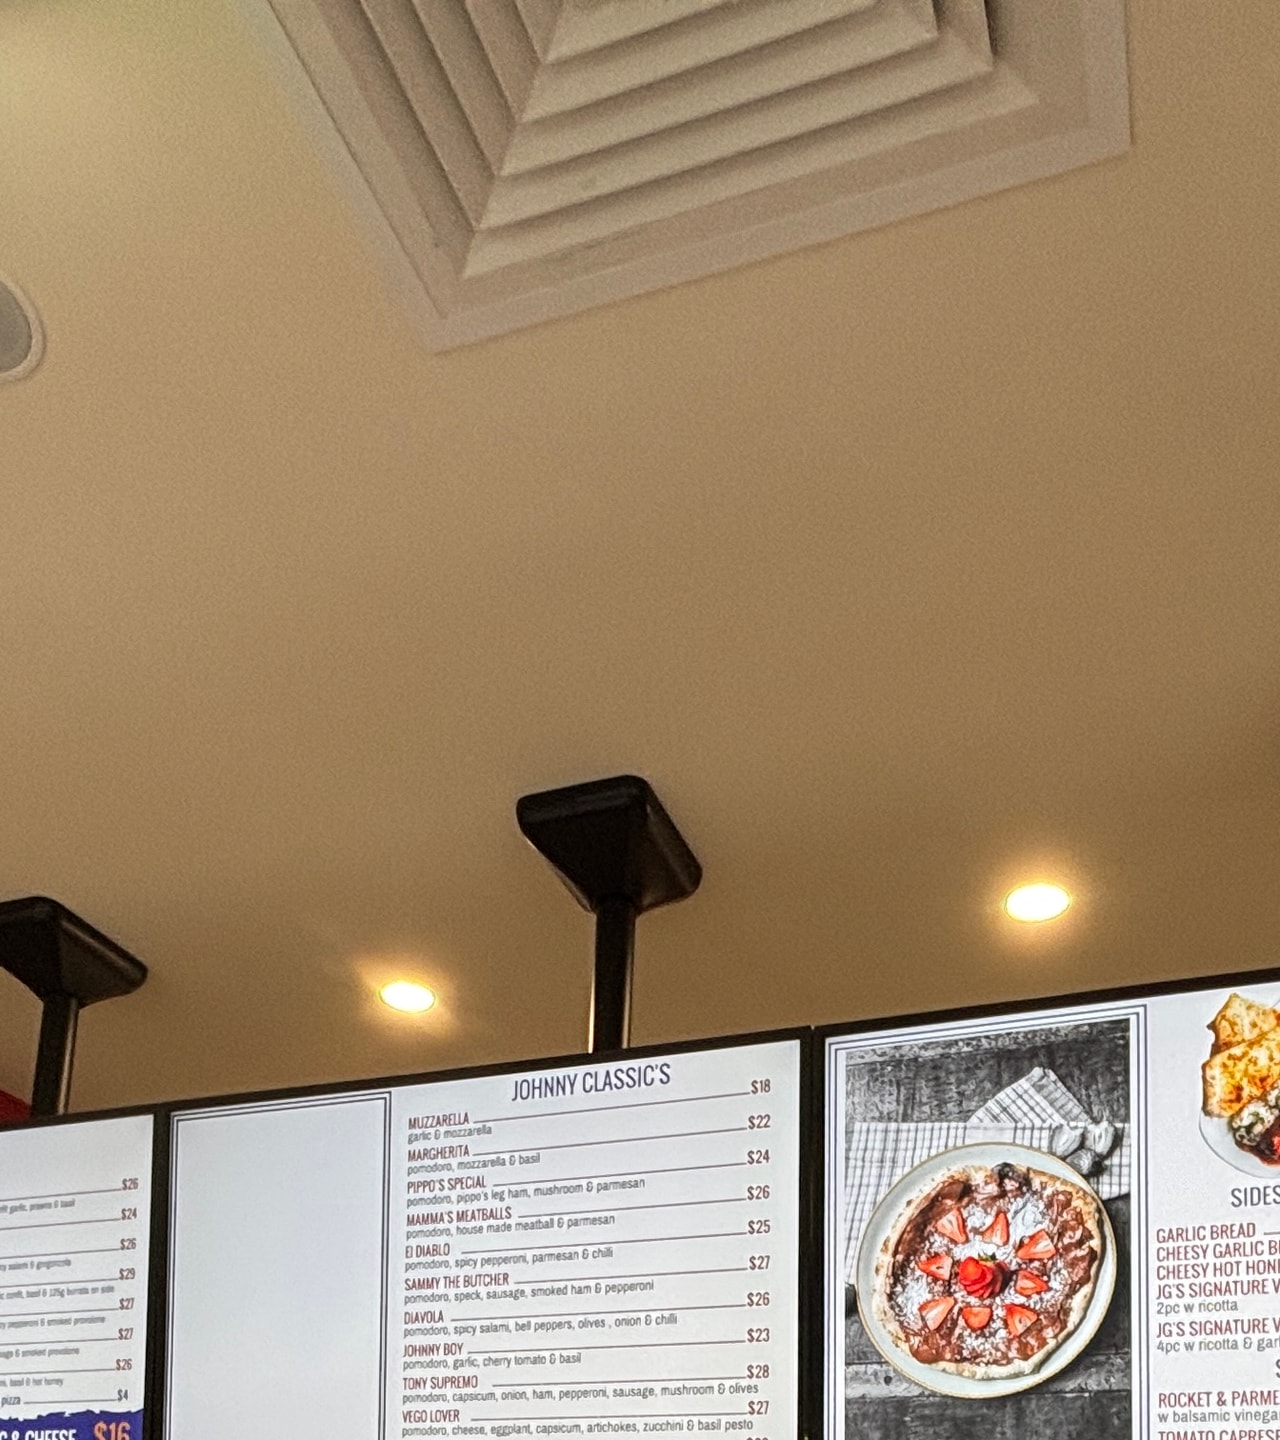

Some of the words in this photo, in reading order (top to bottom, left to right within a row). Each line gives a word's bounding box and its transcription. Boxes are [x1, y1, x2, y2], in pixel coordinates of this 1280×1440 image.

[511, 1073, 578, 1102] JOHNNY
[582, 1062, 671, 1093] CLASSIC'S
[408, 1111, 469, 1130] MUZZARELLA
[750, 1078, 771, 1095] $18
[407, 1144, 473, 1162] MARGHERITA
[747, 1113, 771, 1130] $22
[447, 1175, 487, 1191] SPECIAL
[747, 1148, 770, 1165] $24
[456, 1205, 512, 1223] MEATBALLS
[746, 1184, 770, 1201] $26
[415, 1242, 450, 1258] DIABLO
[747, 1219, 771, 1235] $25
[1156, 1225, 1206, 1244] GARLIC
[1210, 1222, 1256, 1240] BREAD
[1156, 1243, 1209, 1262] CHEESY
[1212, 1240, 1264, 1259] GARLIC
[404, 1276, 441, 1291] SAMMY
[442, 1274, 460, 1289] THE
[463, 1272, 509, 1288] BUTCHER
[749, 1254, 770, 1271] $27
[1156, 1262, 1210, 1281] CHEESY
[1213, 1260, 1242, 1278] HOT
[1188, 1278, 1269, 1298] SIGNATURE
[403, 1309, 444, 1325] DIAVOLA
[746, 1291, 770, 1307] $26
[1156, 1301, 1180, 1317] 2pc
[1183, 1303, 1195, 1313] w
[1198, 1299, 1239, 1313] ricotta
[1188, 1317, 1270, 1336] SIGNATURE
[402, 1343, 441, 1358] JOHNNY
[443, 1342, 464, 1356] BOY
[746, 1327, 770, 1343] $23
[1156, 1339, 1180, 1355] 4pc
[1183, 1341, 1195, 1351] w
[1198, 1338, 1239, 1351] ricotta
[1242, 1336, 1253, 1350] &
[402, 1377, 428, 1390] TONY
[429, 1374, 478, 1390] SUPREMO
[746, 1364, 769, 1379] $28
[401, 1409, 428, 1424] VEGO
[429, 1408, 460, 1423] LOVER
[747, 1400, 769, 1416] $27
[1158, 1391, 1212, 1409] ROCKET
[1216, 1390, 1227, 1407] &
[1157, 1413, 1169, 1423] w
[1172, 1408, 1230, 1423] balsamic
